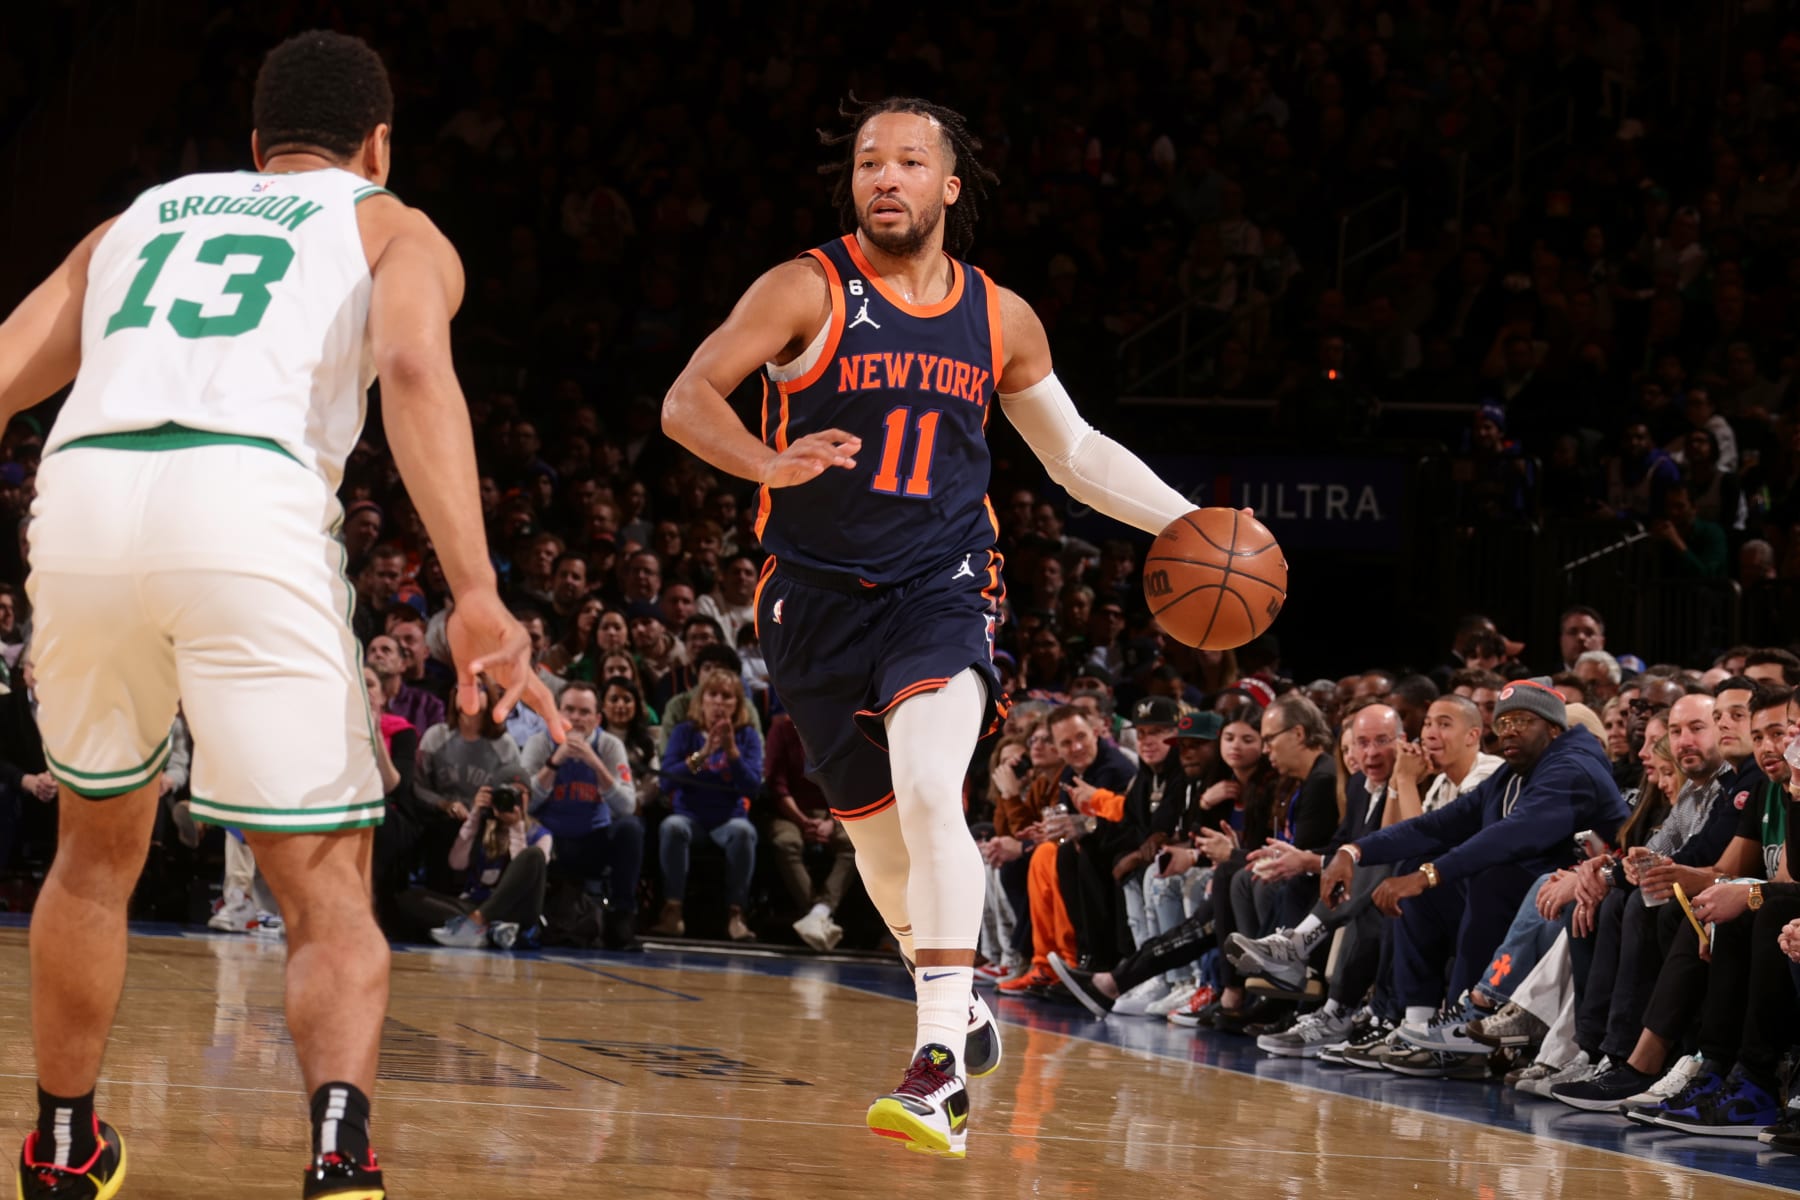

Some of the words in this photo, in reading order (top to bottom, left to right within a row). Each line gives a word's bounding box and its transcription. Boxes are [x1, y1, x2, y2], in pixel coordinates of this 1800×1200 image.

[158, 195, 324, 232] BROGDON
[103, 231, 296, 340] 13
[848, 279, 864, 296] 6
[837, 352, 914, 393] NEW
[916, 352, 989, 407] YORK
[869, 405, 944, 499] 11
[1242, 481, 1383, 521] ULTRA
